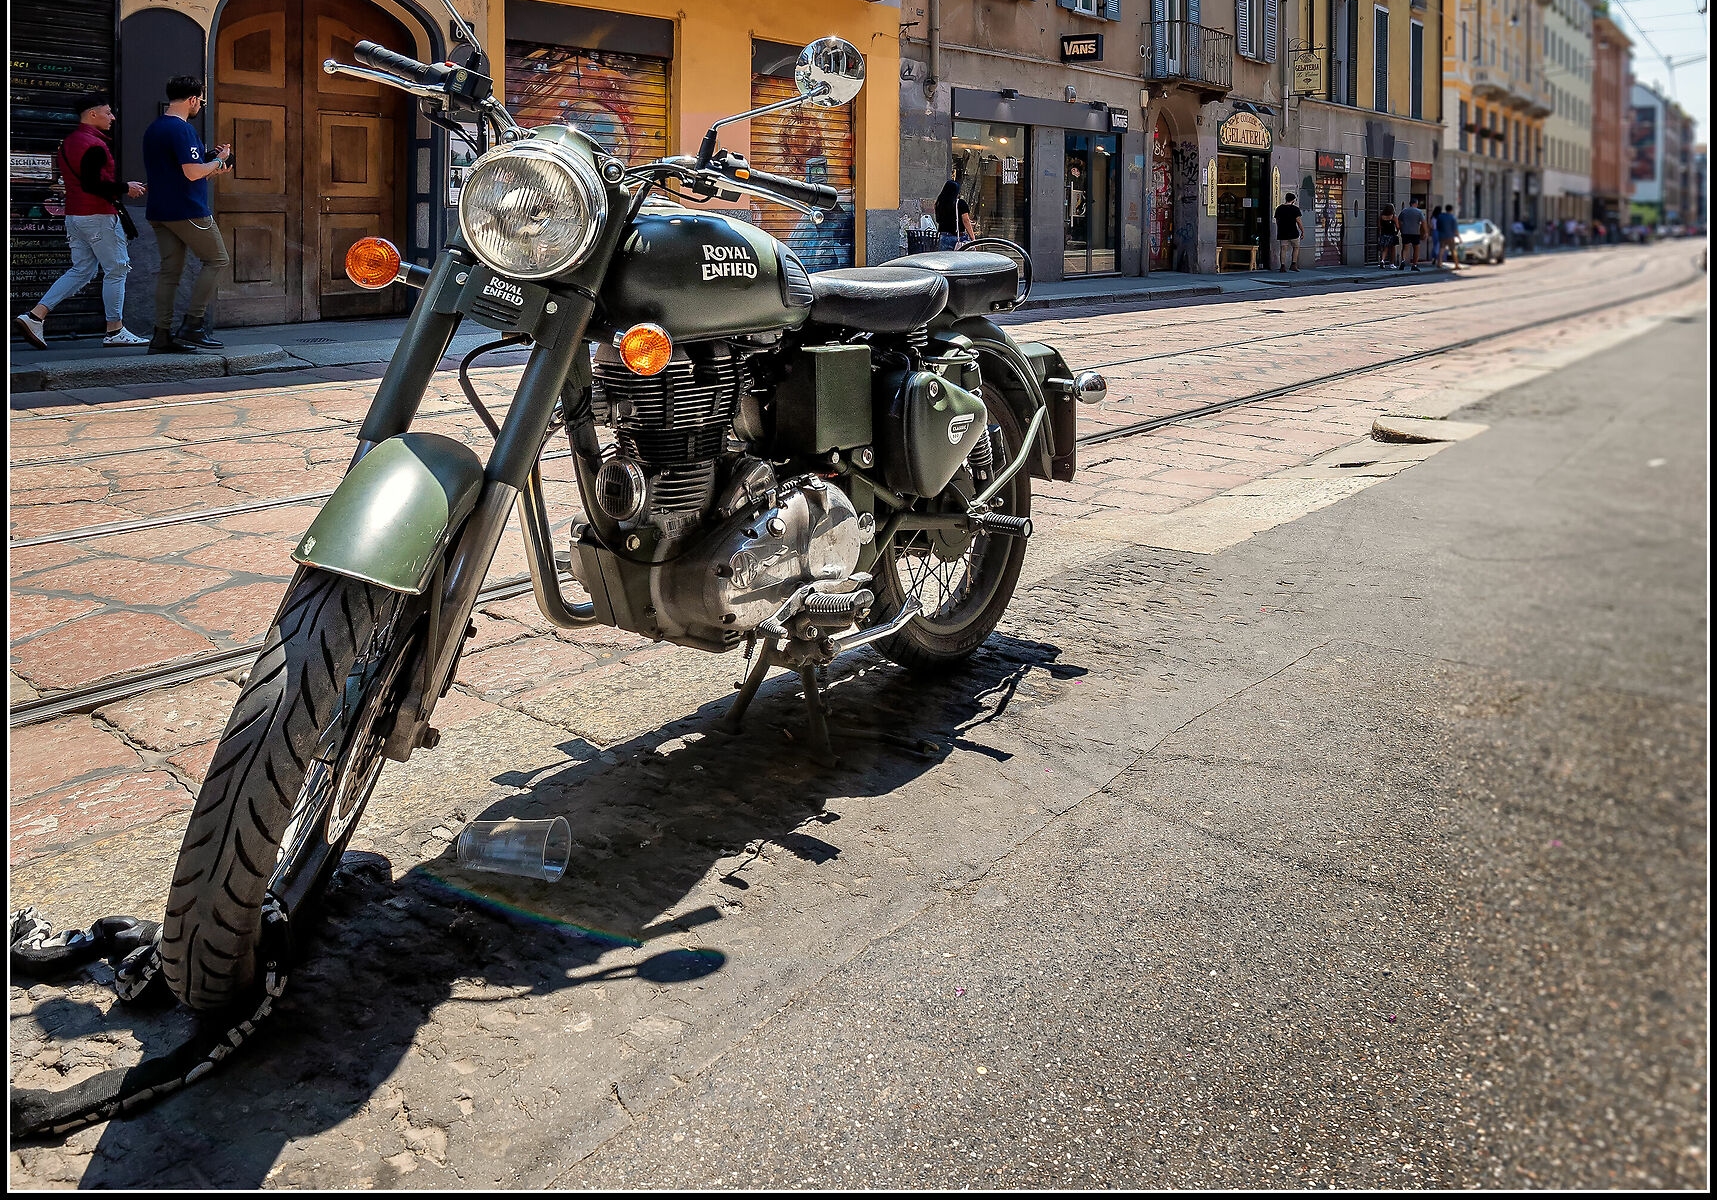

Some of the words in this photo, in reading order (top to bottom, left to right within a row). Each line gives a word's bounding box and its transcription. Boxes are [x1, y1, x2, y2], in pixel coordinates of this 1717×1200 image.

[1063, 40, 1096, 55] VANS
[1225, 127, 1266, 145] GELATERIA
[190, 146, 199, 159] 3
[702, 244, 751, 261] ROYAL
[701, 262, 758, 280] ENFIELD
[490, 276, 522, 296] ROYAL
[482, 285, 524, 306] ENFIELD
